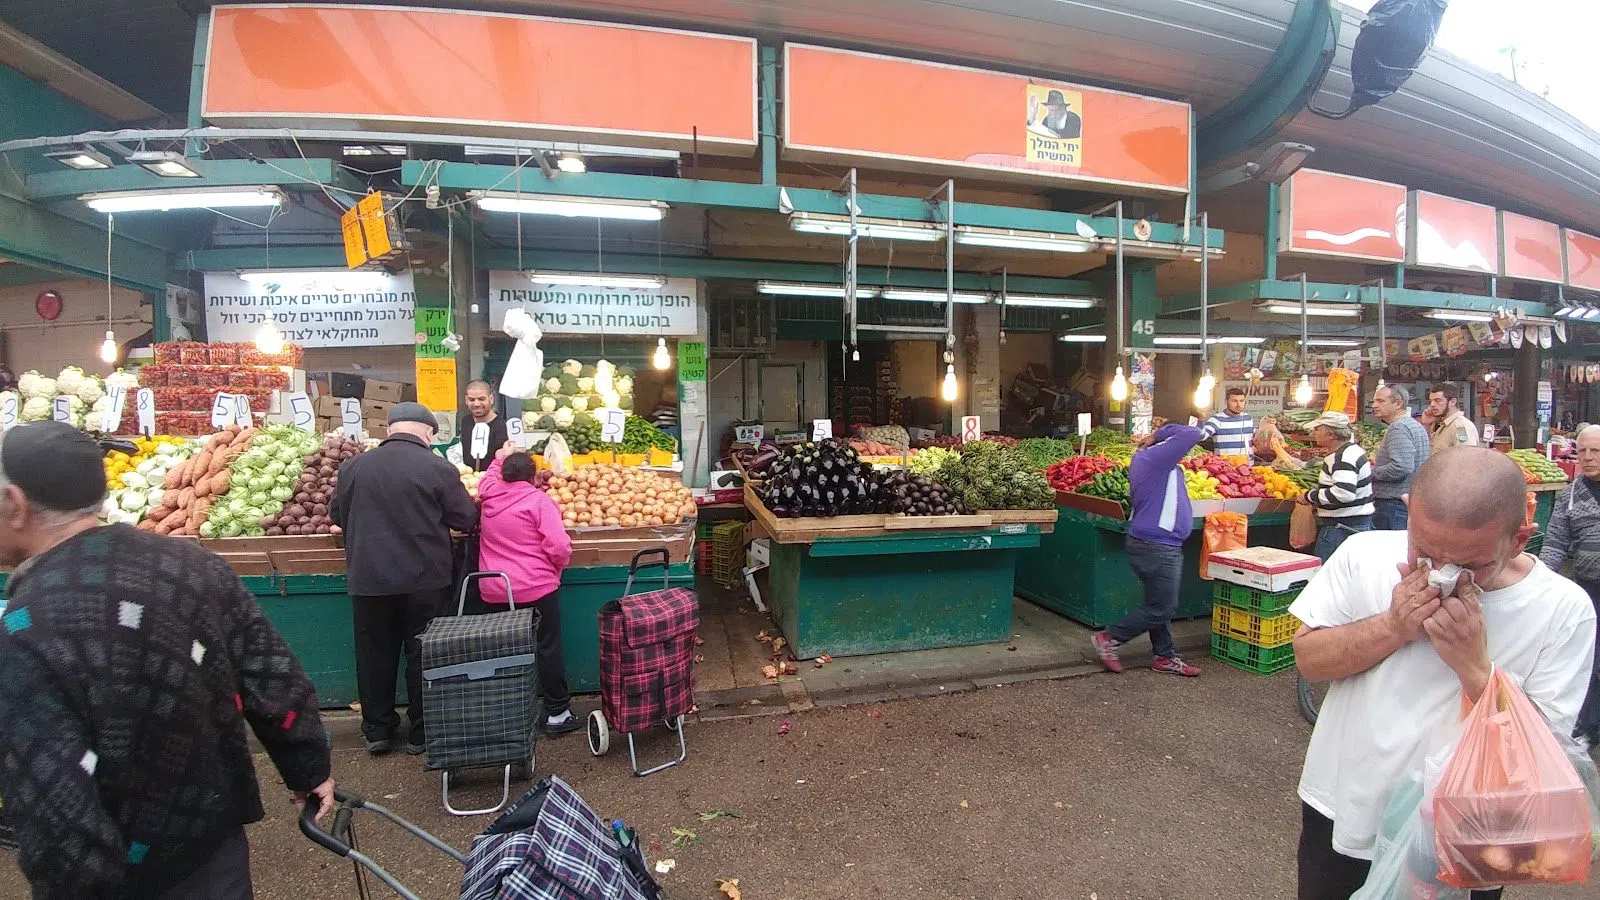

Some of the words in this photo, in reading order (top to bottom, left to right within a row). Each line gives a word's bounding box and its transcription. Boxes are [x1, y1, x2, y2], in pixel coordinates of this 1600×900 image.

[1029, 137, 1059, 150] המלך
[1062, 142, 1079, 152] יחי
[1037, 150, 1074, 163] המשיח
[209, 295, 257, 308] ושירות
[259, 294, 298, 306] איכות
[301, 293, 339, 305] טריים
[343, 291, 398, 304] מובחרים
[575, 292, 632, 306] תרומות
[635, 294, 691, 308] הופרשו
[220, 311, 239, 325] זול
[243, 313, 266, 324] הכי
[300, 310, 364, 323] מתחייבים
[366, 308, 396, 321] הכול
[398, 307, 415, 320] על
[425, 309, 446, 322] ירק
[572, 312, 601, 326] הרב
[605, 314, 671, 328] בהשגחת
[1132, 319, 1155, 335] 45
[276, 328, 314, 341] לצרכ
[317, 328, 379, 342] מהחקלאי
[425, 327, 447, 337] גוש
[420, 344, 450, 356] קטיף
[685, 342, 701, 353] ירק
[686, 356, 702, 365] גוש
[682, 369, 705, 380] קטיף
[110, 386, 120, 412] 4
[139, 391, 149, 411] 8
[215, 395, 234, 416] 5
[5, 398, 17, 425] 3
[55, 398, 70, 421] 5
[233, 395, 249, 419] 10
[290, 397, 312, 426] 5
[343, 400, 361, 424] 5
[511, 420, 521, 435] 5
[605, 410, 623, 435] 5
[814, 422, 826, 436] 5
[964, 417, 977, 442] 8
[475, 424, 486, 441] 4
[1484, 424, 1494, 441] 3
